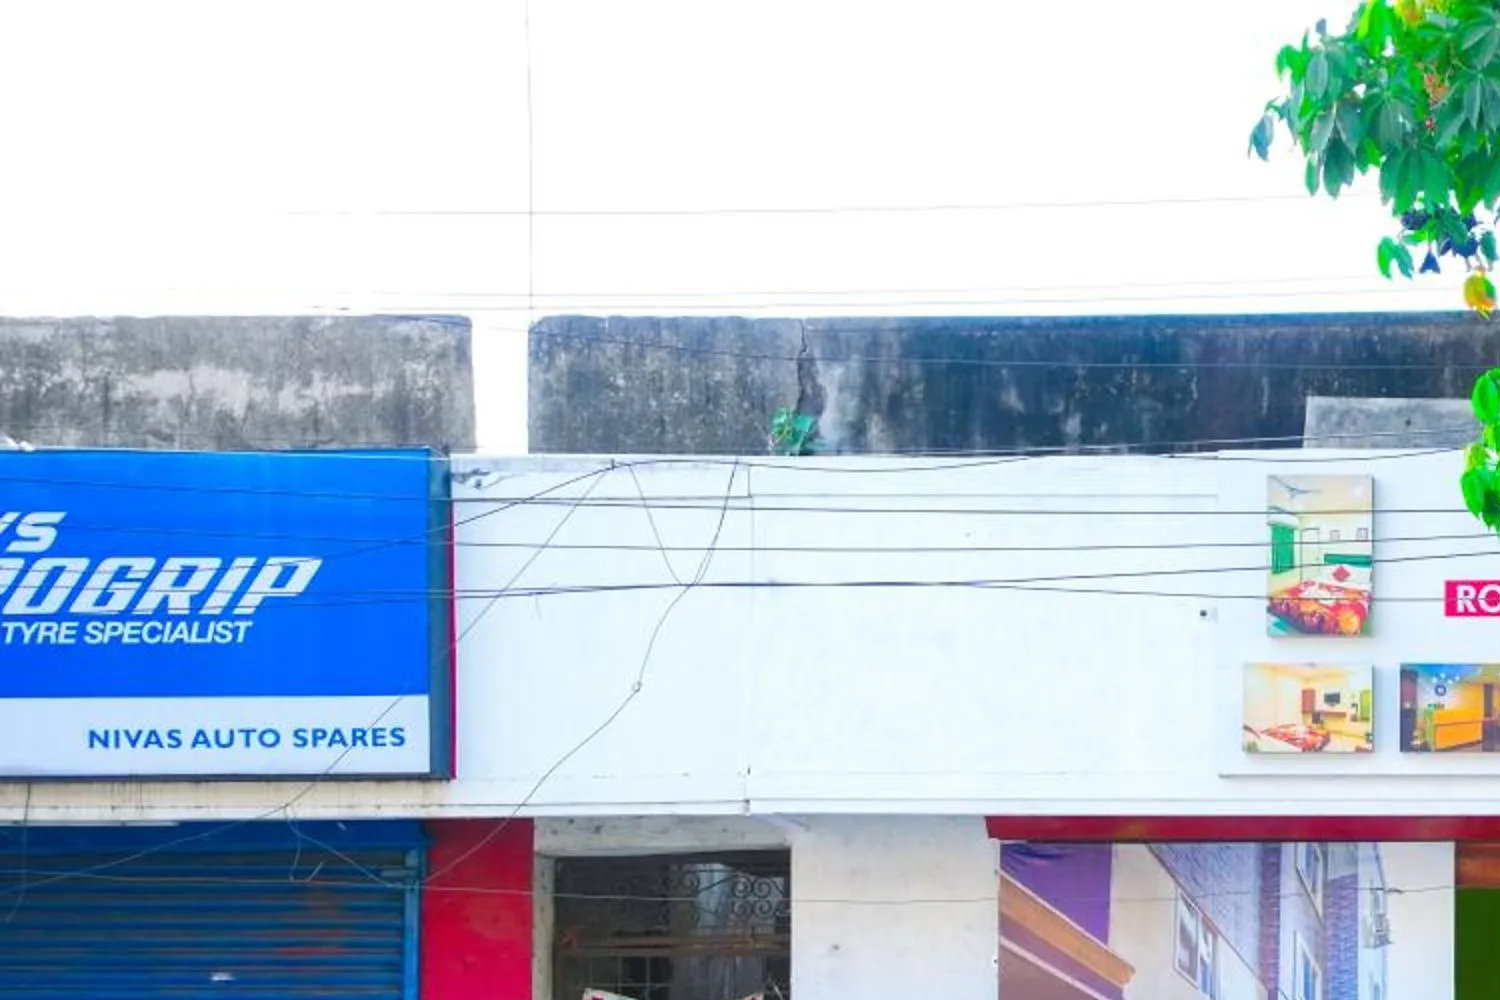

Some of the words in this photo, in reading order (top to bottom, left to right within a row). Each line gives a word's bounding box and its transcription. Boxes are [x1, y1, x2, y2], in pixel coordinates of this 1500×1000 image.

[2, 621, 79, 645] TYRE
[84, 620, 253, 645] SPECIALIST
[88, 728, 182, 750] NIVAS
[191, 728, 281, 749] AUTO
[293, 727, 406, 748] SPARES
